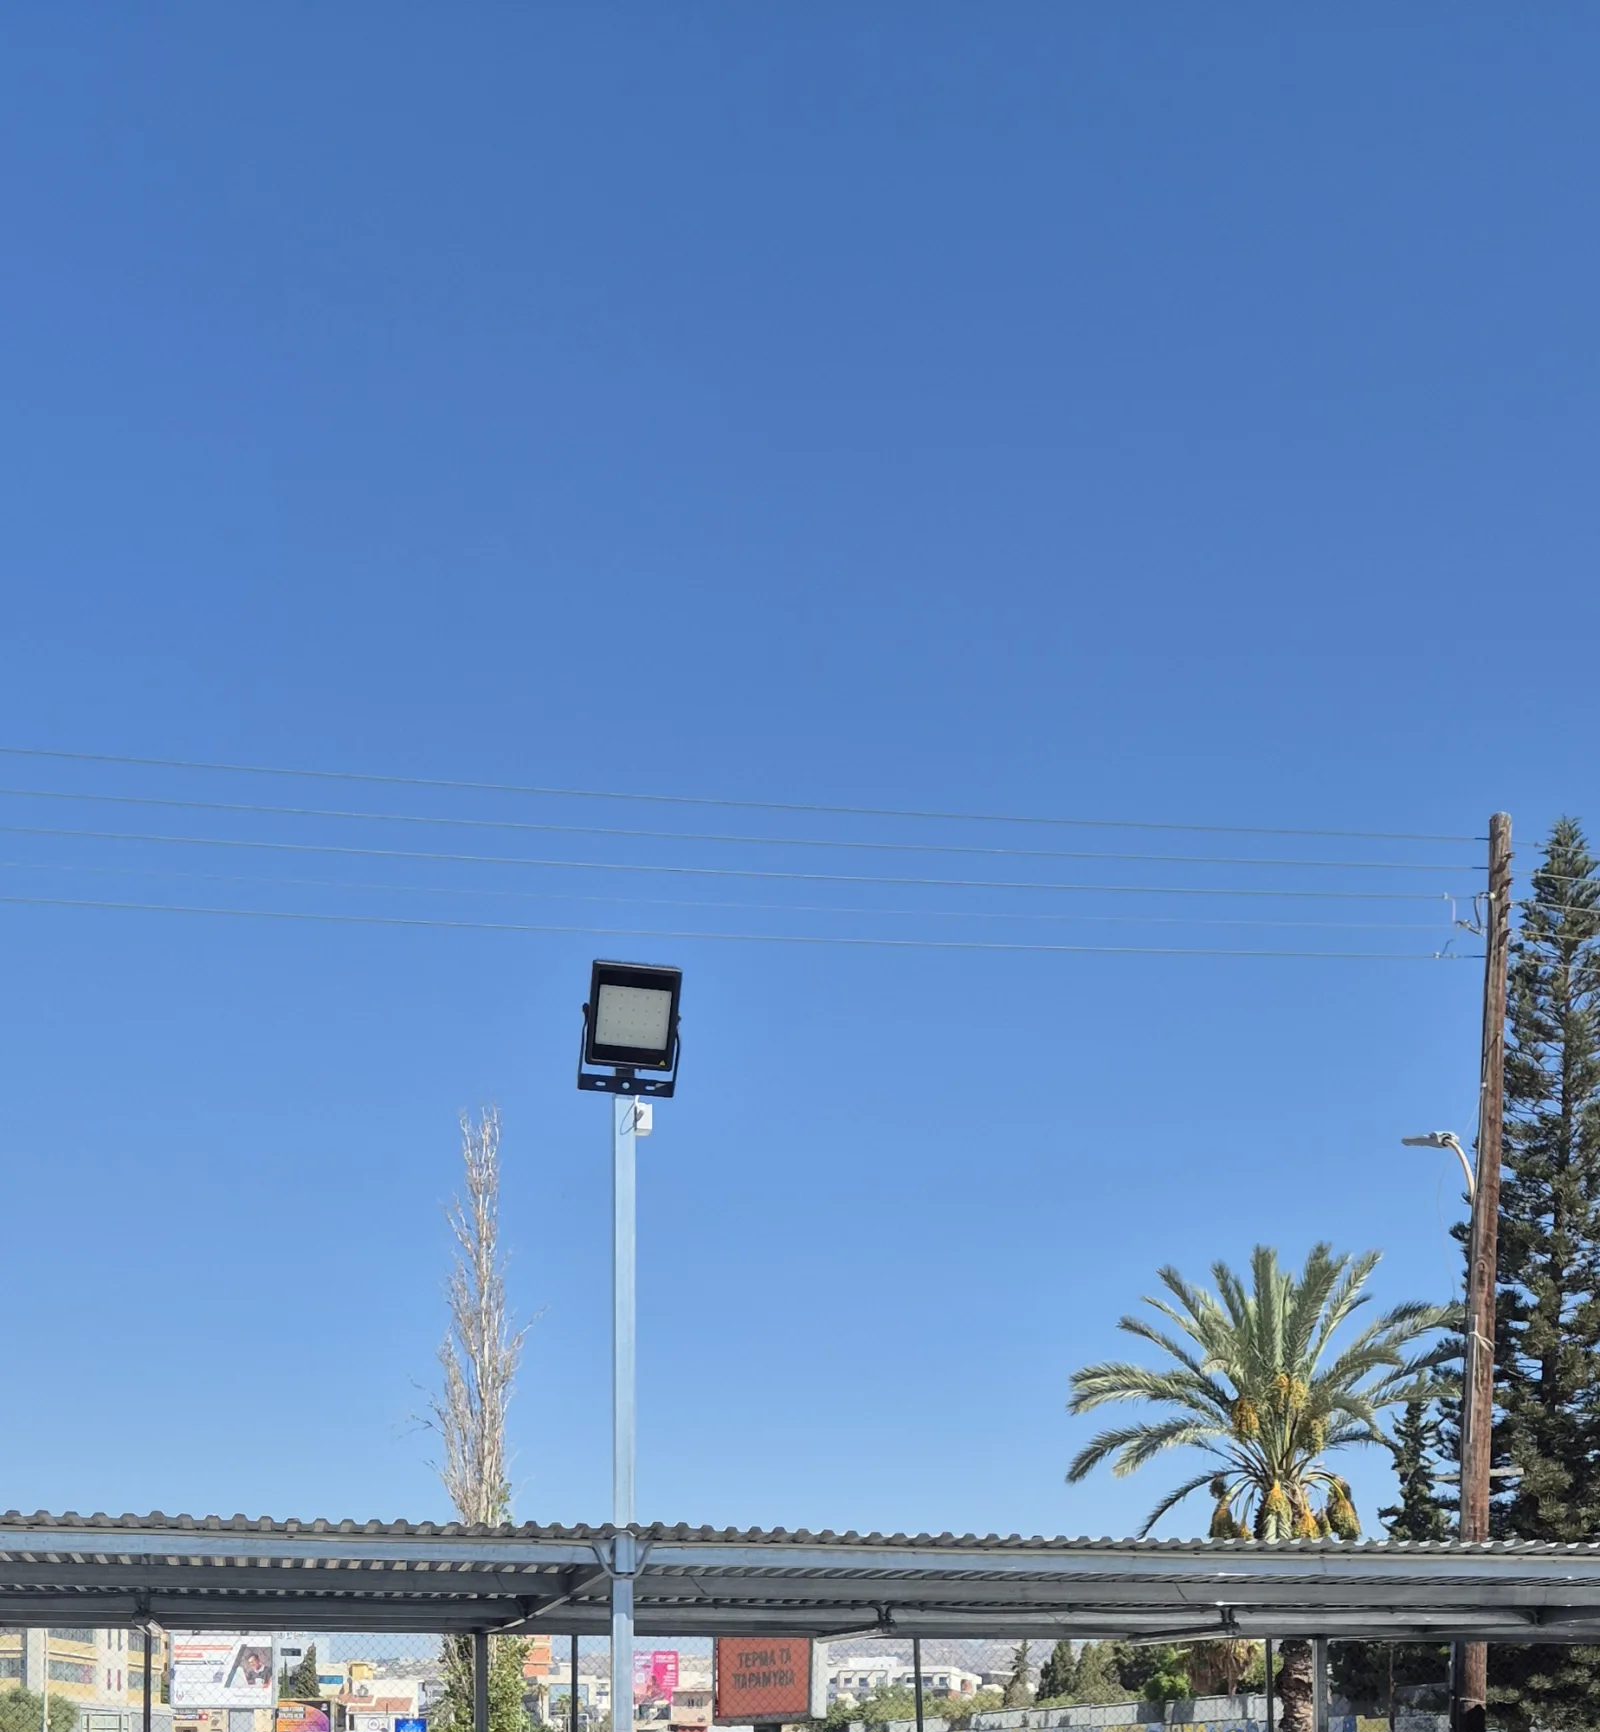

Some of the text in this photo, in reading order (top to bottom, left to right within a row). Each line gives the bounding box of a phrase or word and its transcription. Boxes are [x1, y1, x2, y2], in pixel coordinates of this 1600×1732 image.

[737, 1647, 792, 1669] ΤΕΡΜΑ ΤΑ
[732, 1669, 795, 1690] ΠΑΡΑΜΥΘΙΑ
